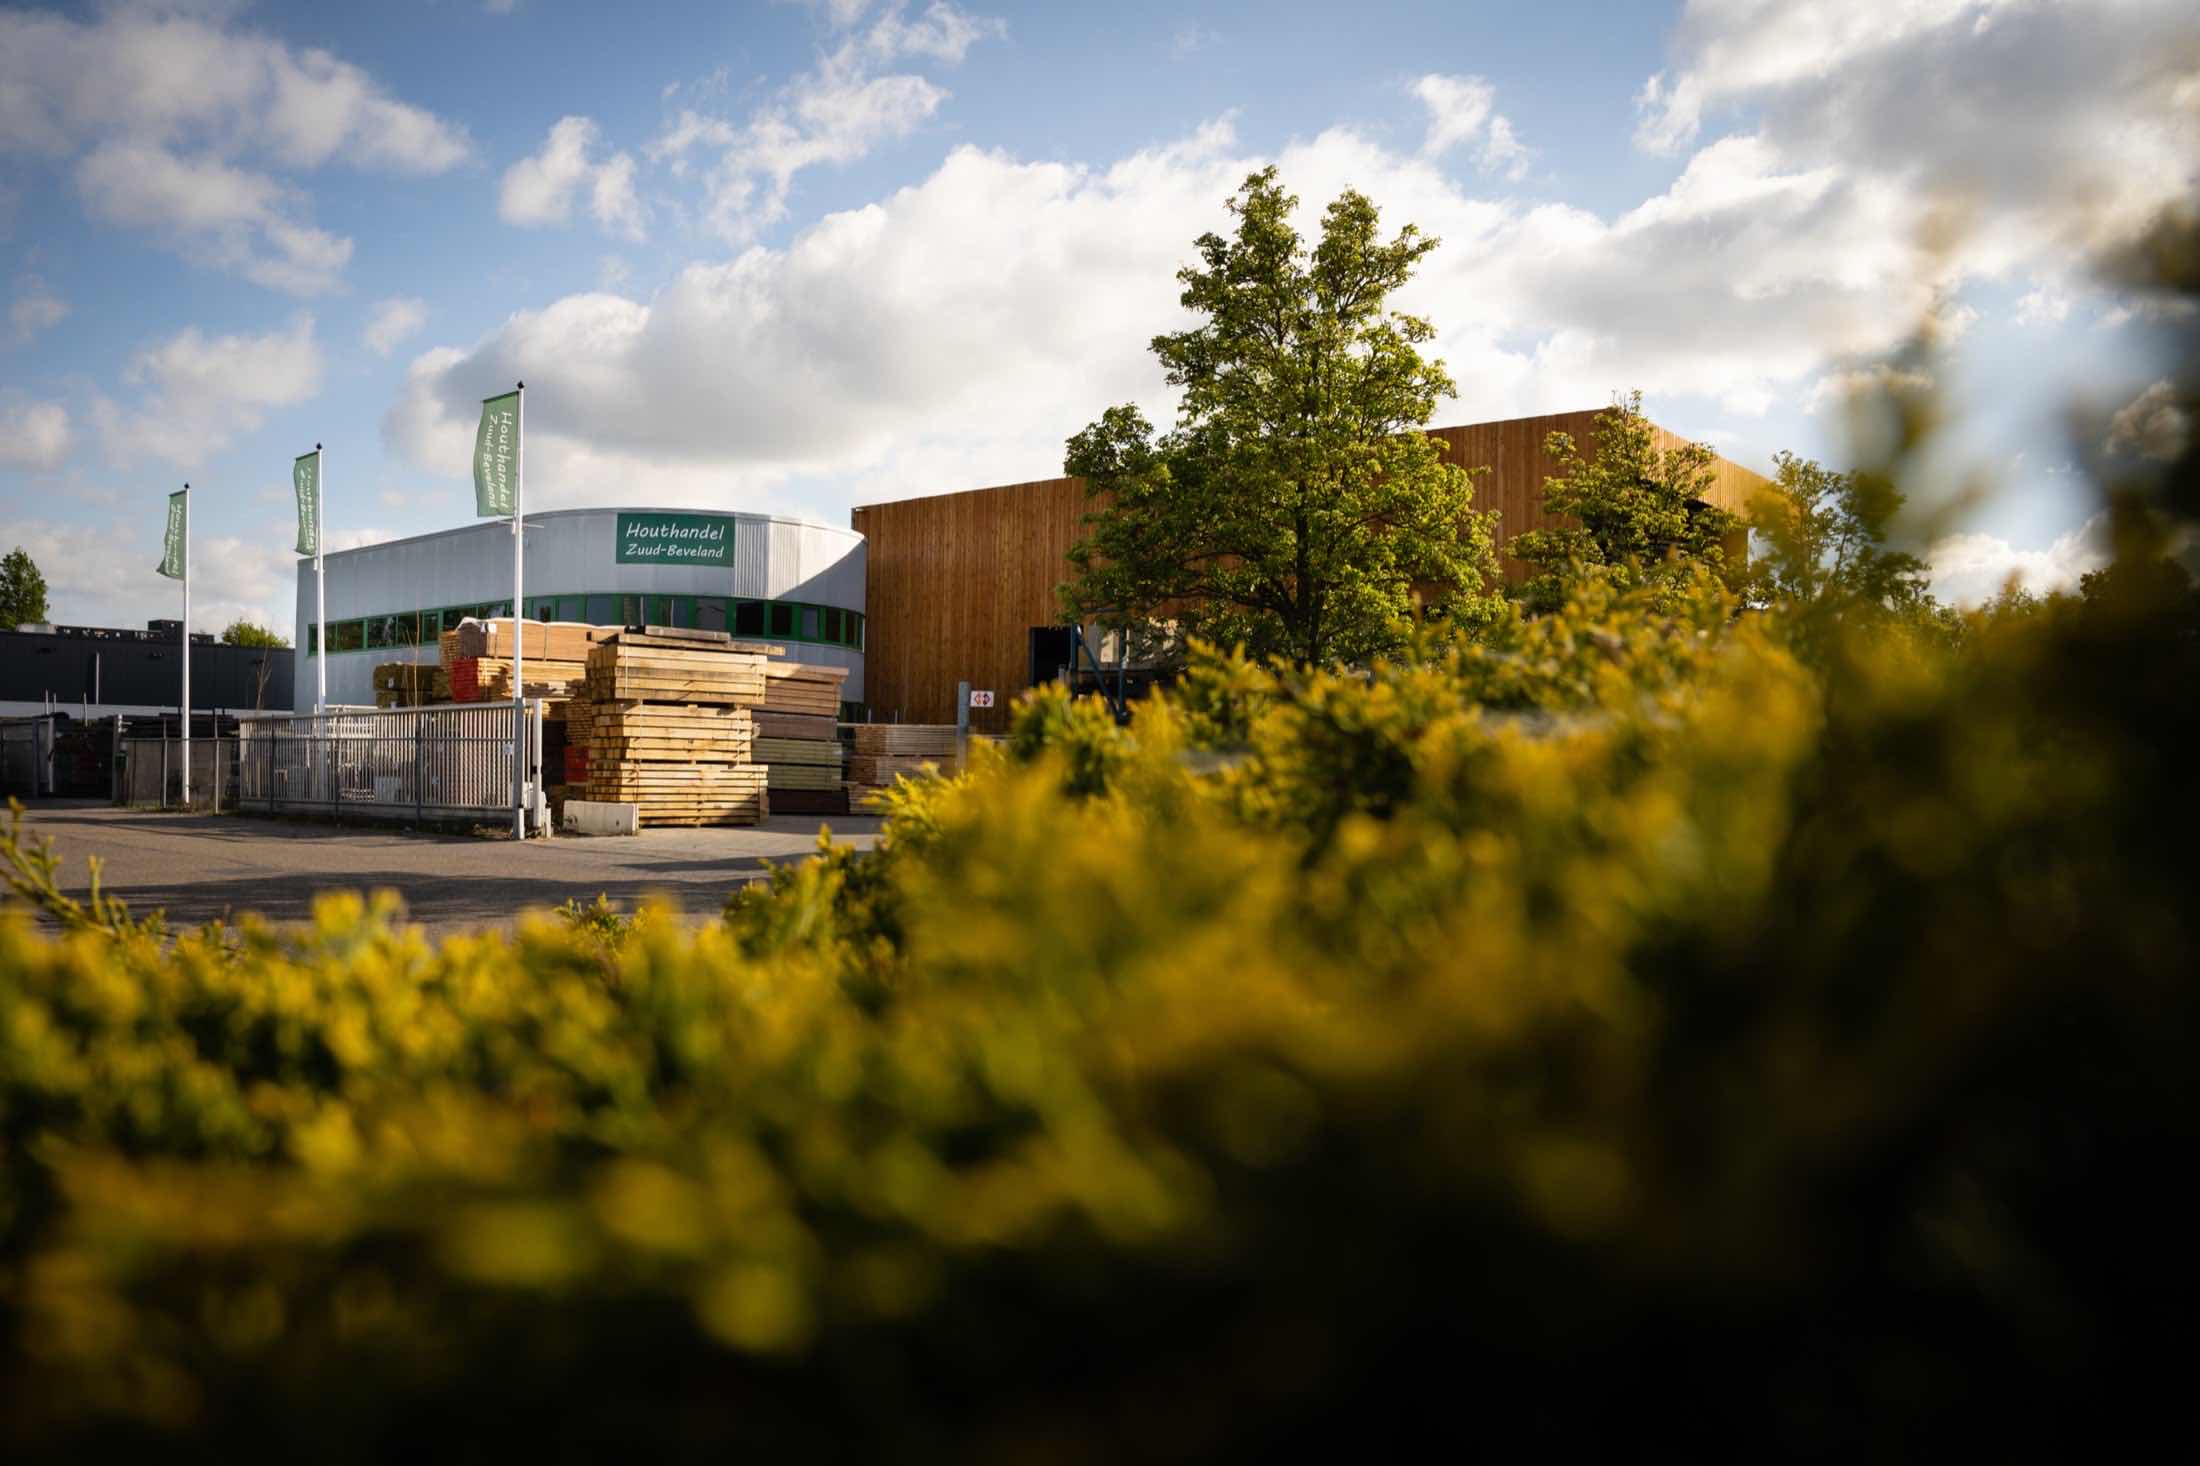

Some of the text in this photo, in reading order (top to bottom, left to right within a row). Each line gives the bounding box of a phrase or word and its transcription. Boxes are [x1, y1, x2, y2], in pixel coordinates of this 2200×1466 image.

[497, 411, 512, 508] Houthandel
[626, 522, 725, 541] Houthandel
[625, 543, 724, 558] Zuud-Beveland
